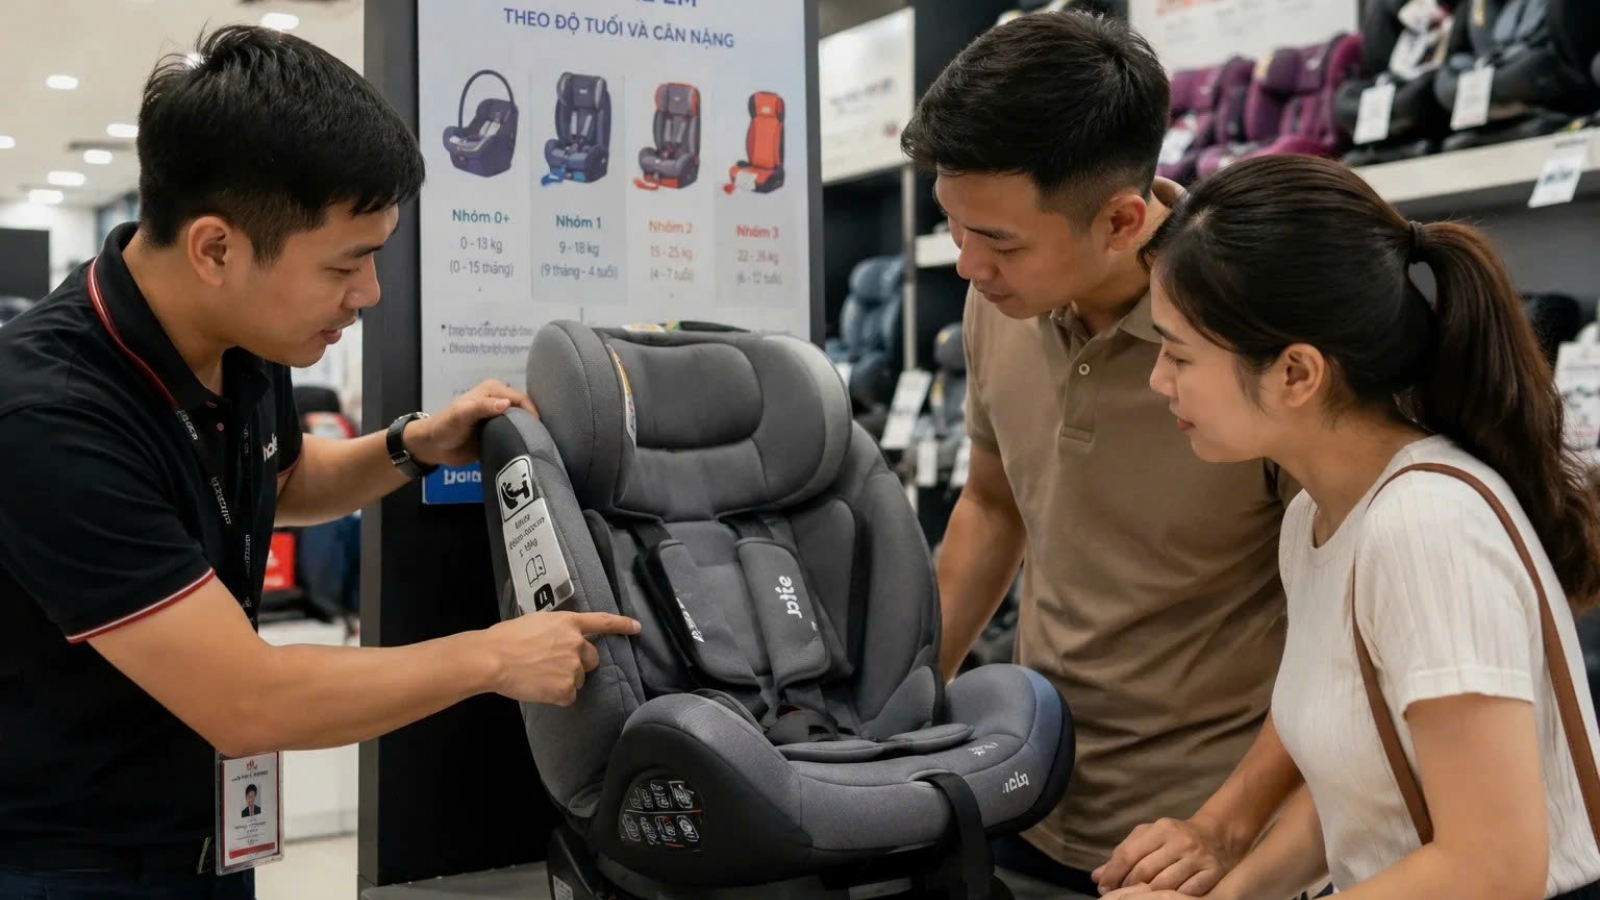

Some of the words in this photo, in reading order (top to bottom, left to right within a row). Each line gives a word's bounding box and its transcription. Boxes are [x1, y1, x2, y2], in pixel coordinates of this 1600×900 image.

[503, 7, 550, 28] THEO
[555, 12, 580, 36] ĐỘ
[627, 20, 649, 39] VÀ
[452, 209, 491, 223] Nhóm
[494, 211, 510, 224] 0+
[556, 214, 593, 229] Nhóm
[596, 216, 602, 229] 1
[684, 221, 693, 235] 2
[460, 236, 468, 250] 0
[477, 237, 488, 250] 13
[490, 237, 503, 254] kg
[559, 241, 567, 254] 9
[575, 241, 585, 255] 18
[587, 241, 600, 258] kg
[449, 260, 460, 274] (0
[469, 260, 480, 275] 15
[541, 263, 551, 278] (9
[588, 265, 595, 276] 4
